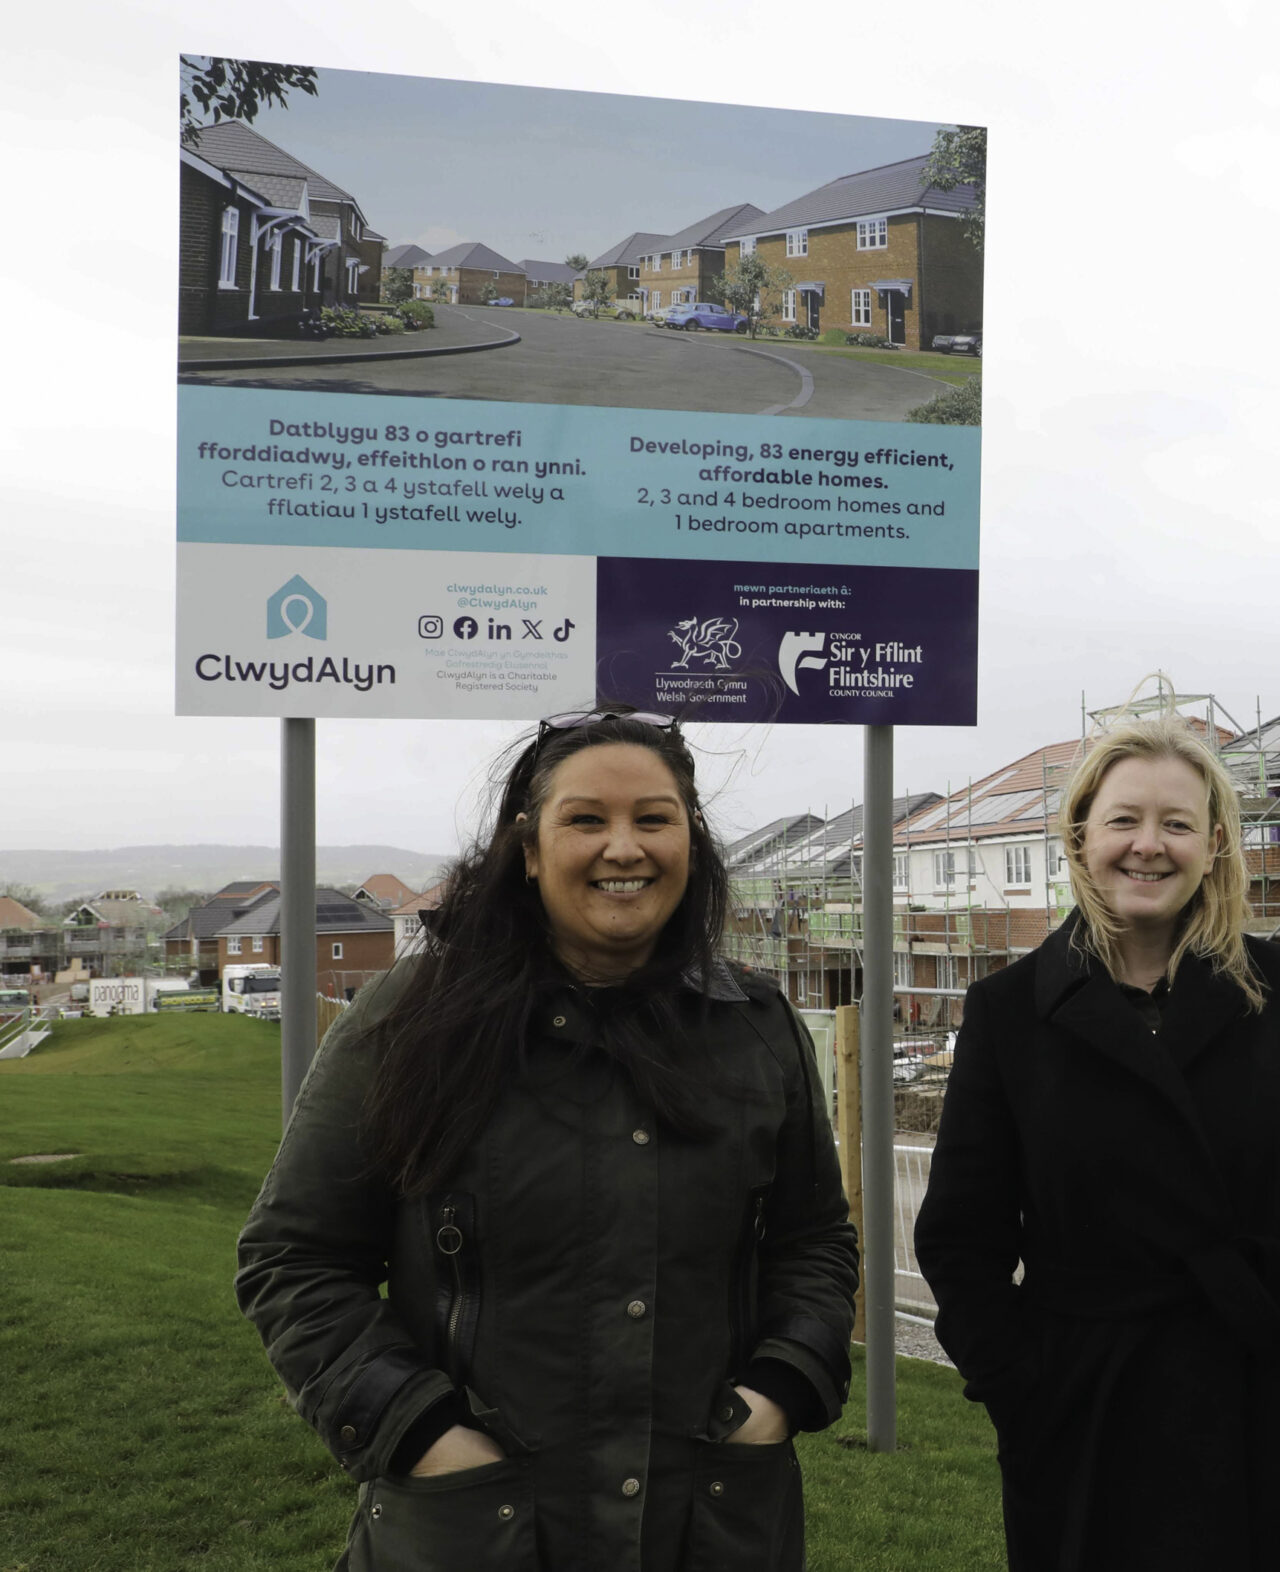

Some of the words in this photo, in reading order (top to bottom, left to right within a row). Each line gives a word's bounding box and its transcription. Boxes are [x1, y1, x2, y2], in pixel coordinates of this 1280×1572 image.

[269, 419, 378, 444] Datblygu
[384, 425, 410, 442] 83
[416, 429, 429, 443] o
[434, 429, 522, 448] gartrefi
[198, 442, 352, 470] fforddiadwy,
[357, 451, 467, 471] effeithlon
[473, 457, 486, 472] o
[491, 458, 528, 474] ran
[535, 458, 587, 478] ynni.
[629, 437, 754, 461] Developing,
[760, 444, 783, 460] 83
[788, 447, 858, 468] energy
[864, 449, 955, 471] efficient,
[221, 470, 313, 491] Cartrefi
[320, 474, 338, 495] 2,
[344, 475, 357, 492] 3
[363, 478, 379, 493] a
[384, 477, 398, 494] 4
[403, 477, 487, 500] ystafell
[493, 481, 544, 504] wely
[549, 486, 565, 501] a
[699, 465, 812, 485] affordable
[818, 472, 889, 489] homes.
[267, 499, 355, 519] fflatiau
[361, 502, 369, 518] 1
[375, 502, 460, 524] ystafell
[466, 507, 522, 529] wely.
[637, 488, 655, 506] 2,
[660, 489, 671, 504] 3
[677, 490, 717, 506] and
[724, 492, 736, 507] 4
[742, 492, 831, 512] bedroom
[837, 496, 901, 515] homes
[907, 501, 945, 516] and
[675, 515, 681, 530] 1
[688, 515, 778, 534] bedroom
[784, 519, 910, 540] apartments.
[447, 584, 548, 596] clwydalyn.co.uk
[769, 585, 838, 595] partneriaeth
[457, 597, 537, 611] @ClwydAlyn
[740, 596, 749, 606] in
[752, 598, 816, 610] partnership
[818, 599, 845, 608] with:
[830, 641, 855, 661] Sir
[860, 648, 871, 668] y
[876, 642, 922, 663] Fflint
[195, 654, 395, 691] ClwydAlyn
[437, 670, 487, 681] ClwydAlyn
[507, 672, 557, 680] Charitable
[830, 666, 913, 688] Flintshire
[456, 682, 503, 691] Registered
[505, 682, 538, 692] Society
[656, 692, 686, 702] Welsh
[717, 679, 747, 691] Cymru
